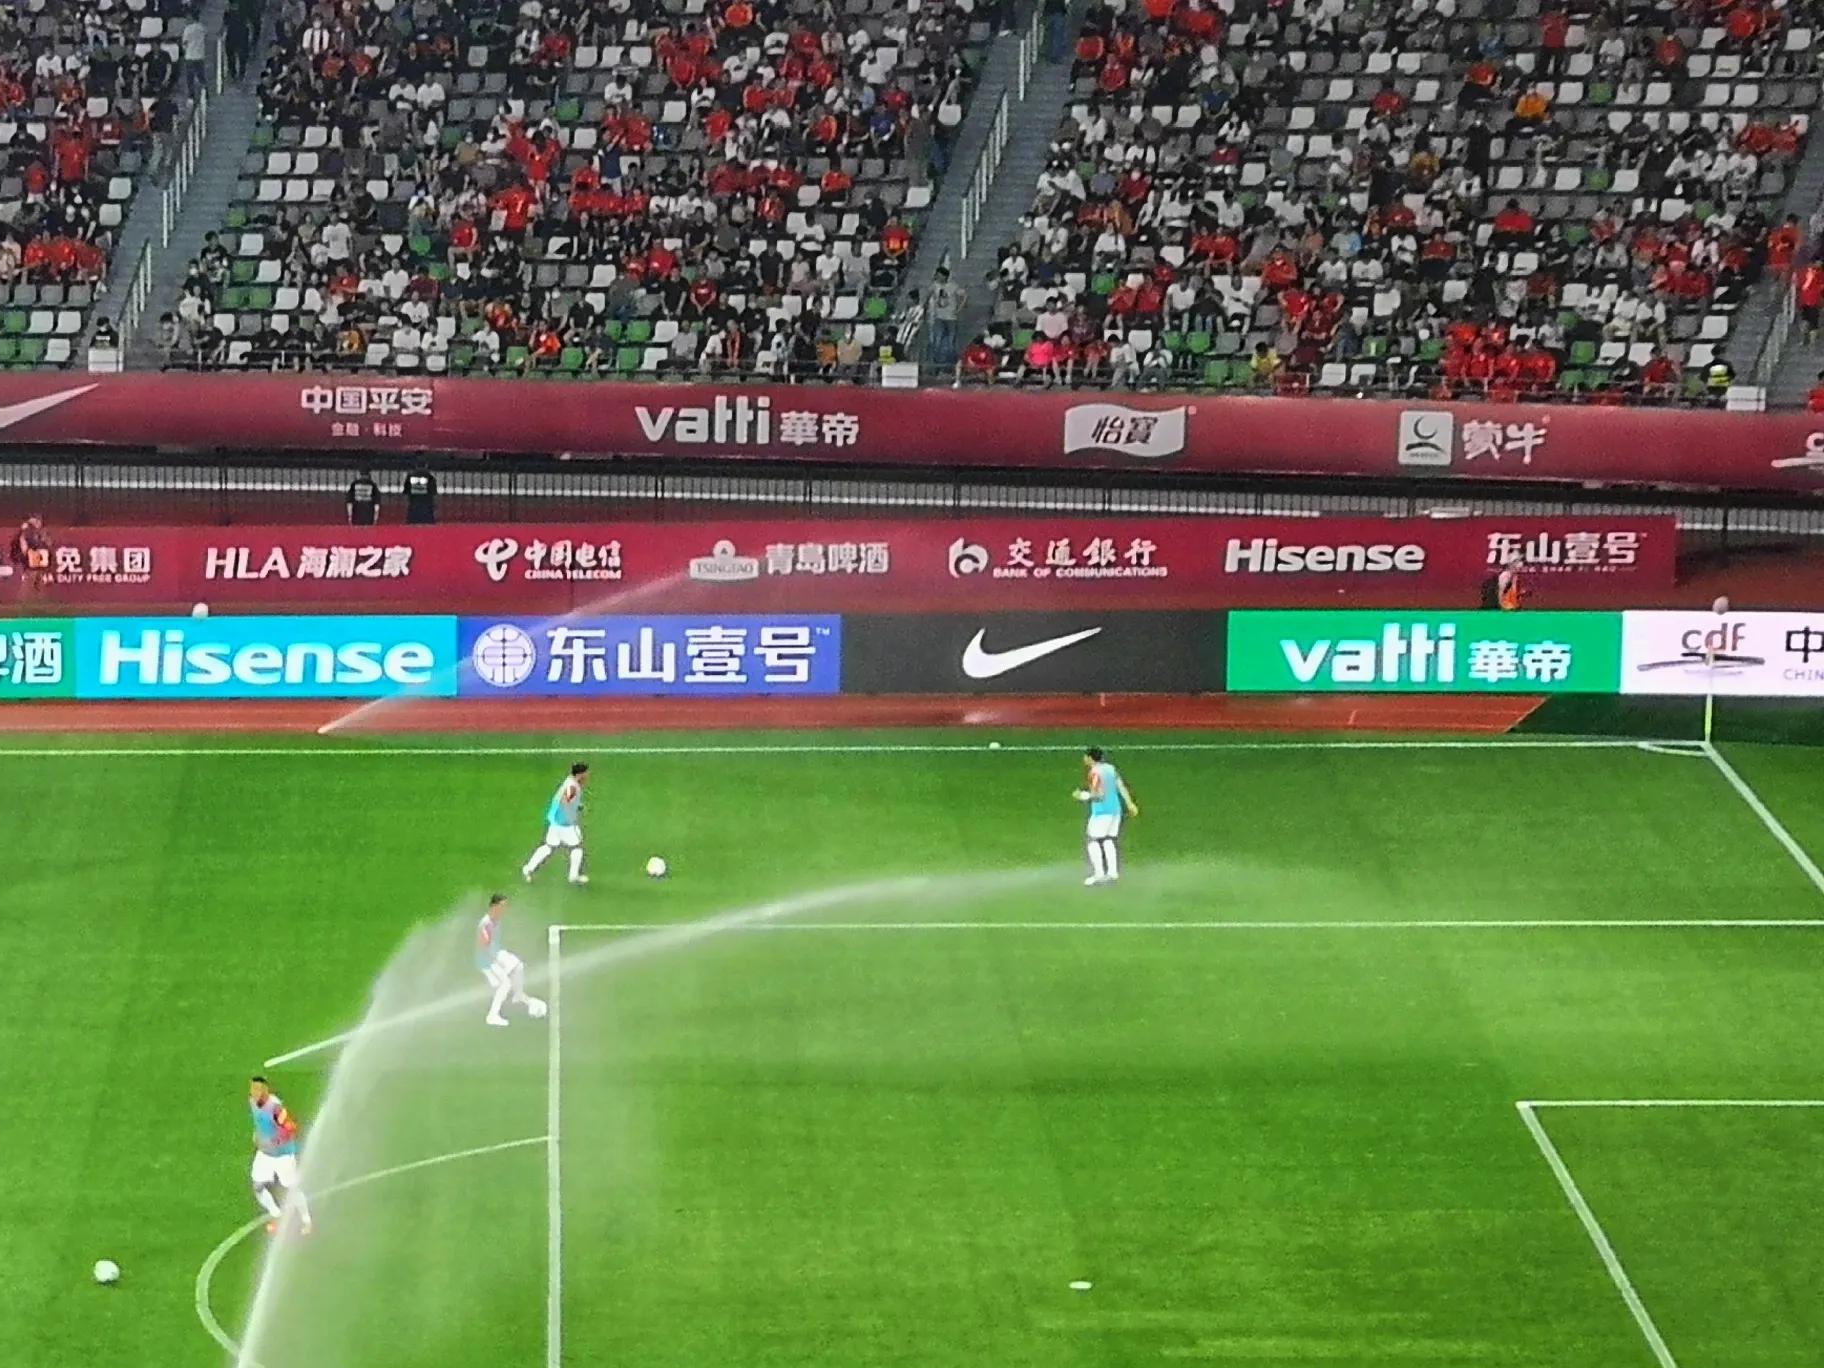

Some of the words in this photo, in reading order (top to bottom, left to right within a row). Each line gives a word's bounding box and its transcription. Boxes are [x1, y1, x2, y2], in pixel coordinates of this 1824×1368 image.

[301, 385, 433, 415] 中国平安
[634, 396, 771, 445] vatti
[779, 411, 860, 447] 華帝
[1091, 415, 1159, 445] 怡寶
[1462, 419, 1548, 465] 蒙牛
[205, 546, 289, 580] HLA
[296, 545, 412, 578] 海澜之家
[524, 539, 622, 570] 中国电信
[1008, 537, 1157, 567] 交通銀行
[1224, 539, 1426, 574] Hisense
[1486, 531, 1640, 565] 东山壹号
[524, 569, 563, 580] CHINA
[565, 569, 622, 580] TELECOM
[696, 563, 754, 574] TSINGTAO
[993, 567, 1028, 578] BANK
[1033, 567, 1051, 578] OF
[1056, 567, 1168, 578] COMMUNICATIONS
[1280, 623, 1457, 683] vatti
[1468, 639, 1573, 683] 華帝
[1681, 622, 1747, 652] cdf
[98, 629, 435, 685] Hisense
[547, 627, 816, 683] 东山壹号
